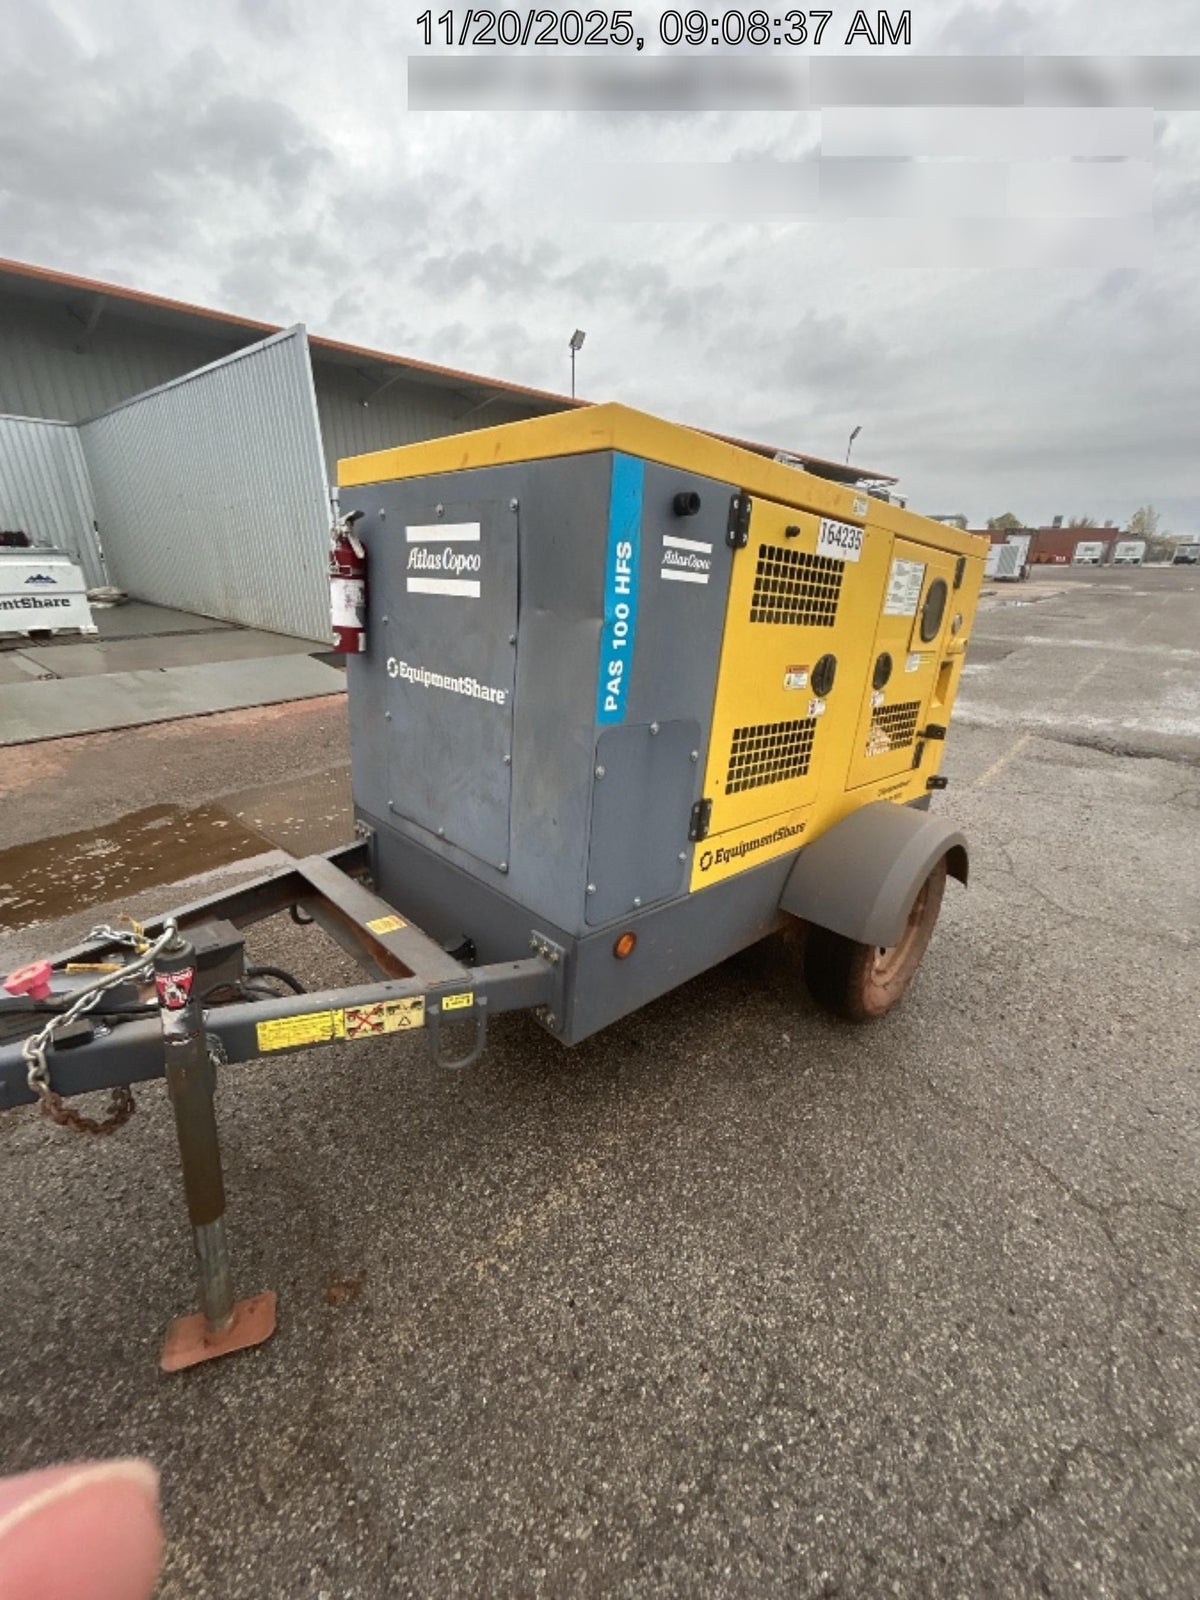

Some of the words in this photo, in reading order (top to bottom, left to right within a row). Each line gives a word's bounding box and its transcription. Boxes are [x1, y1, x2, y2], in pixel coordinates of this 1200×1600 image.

[821, 521, 863, 550] 164235
[406, 546, 442, 570] Atlas
[442, 546, 481, 576] Copco
[615, 541, 632, 594] HFS
[613, 603, 630, 649] 100
[399, 661, 506, 705] EquipmentShare
[604, 659, 624, 711] PAS
[714, 822, 807, 864] EquipmentShare
